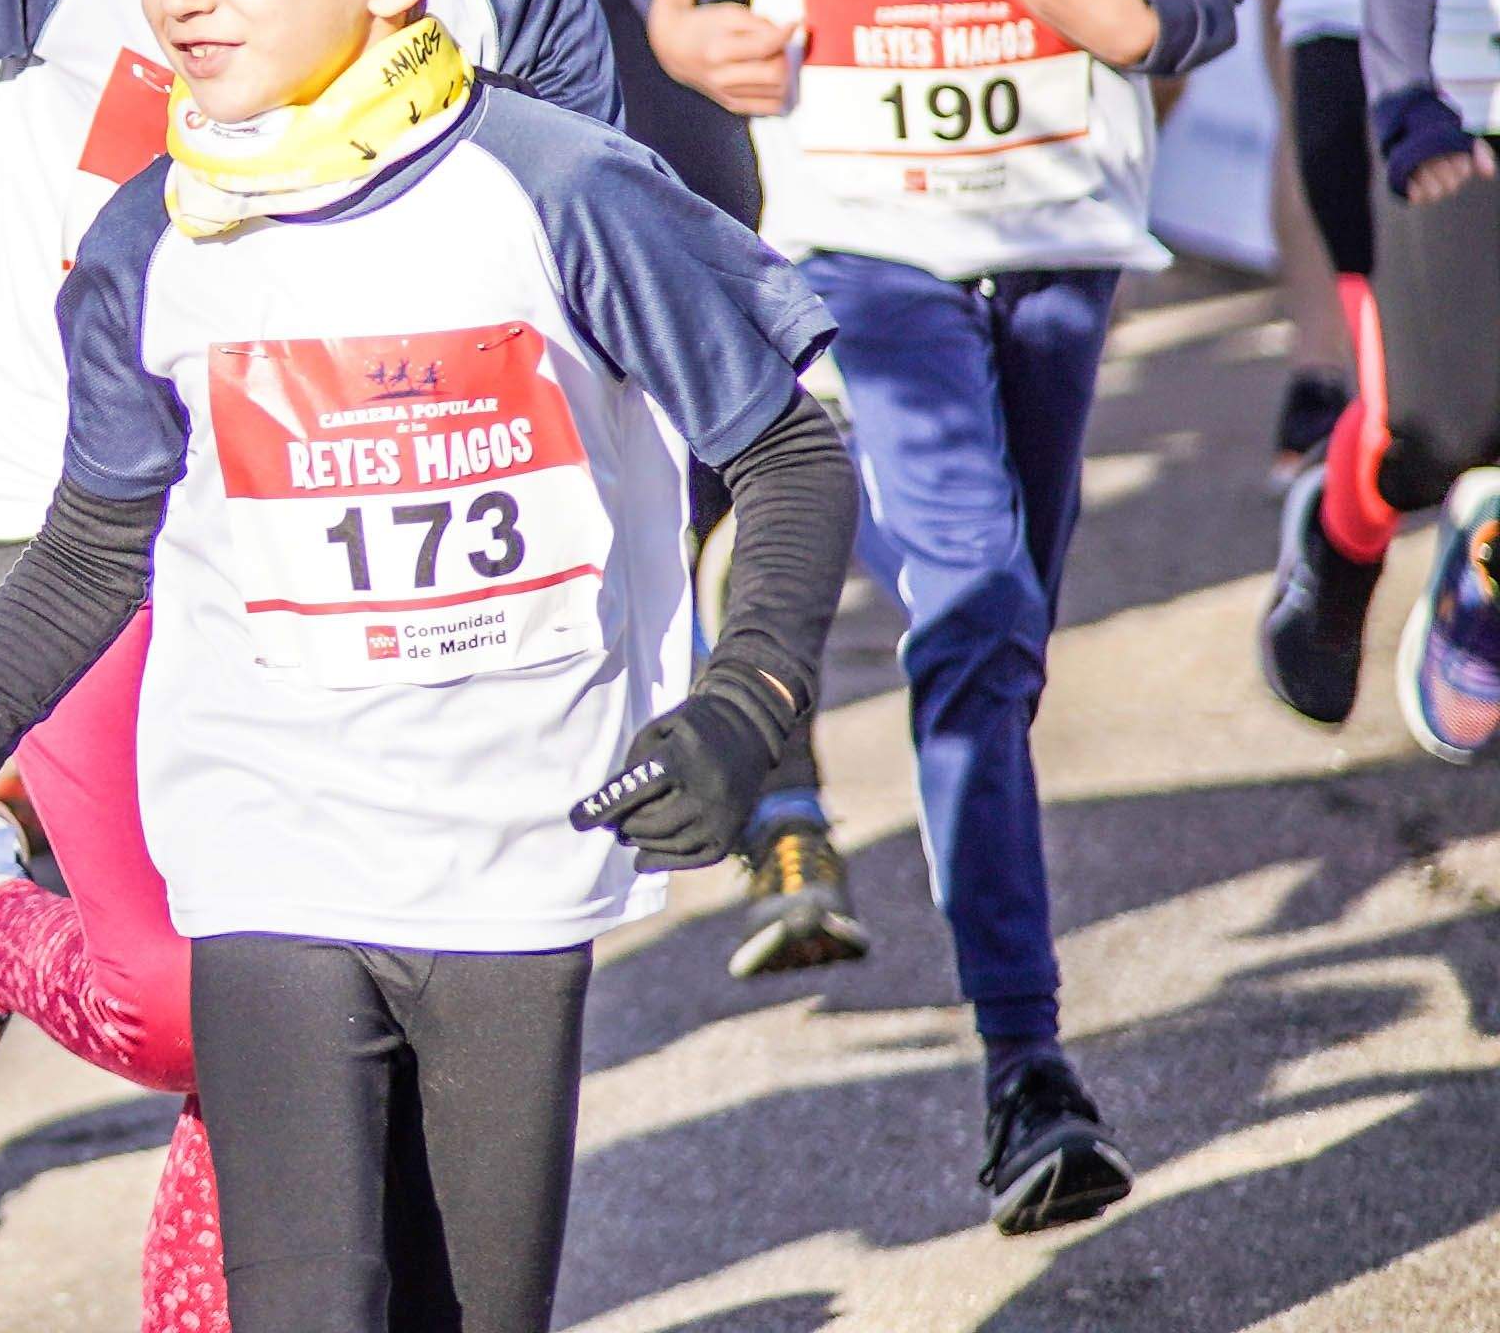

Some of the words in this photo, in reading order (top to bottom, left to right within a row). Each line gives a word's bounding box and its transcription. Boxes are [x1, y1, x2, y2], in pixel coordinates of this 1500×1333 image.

[383, 21, 441, 87] AMIGOS
[853, 24, 935, 68] REYES
[941, 17, 1036, 67] MAGOS
[880, 77, 1022, 142] 190
[318, 406, 409, 429] CARRERA
[411, 398, 499, 420] POPULAR
[287, 438, 402, 491] REYES
[412, 417, 534, 484] MAGOS
[326, 490, 526, 592] 173
[403, 610, 505, 639] Comunidad
[407, 645, 431, 660] de
[440, 630, 508, 655] Madrid
[583, 760, 667, 817] KIPSTA
